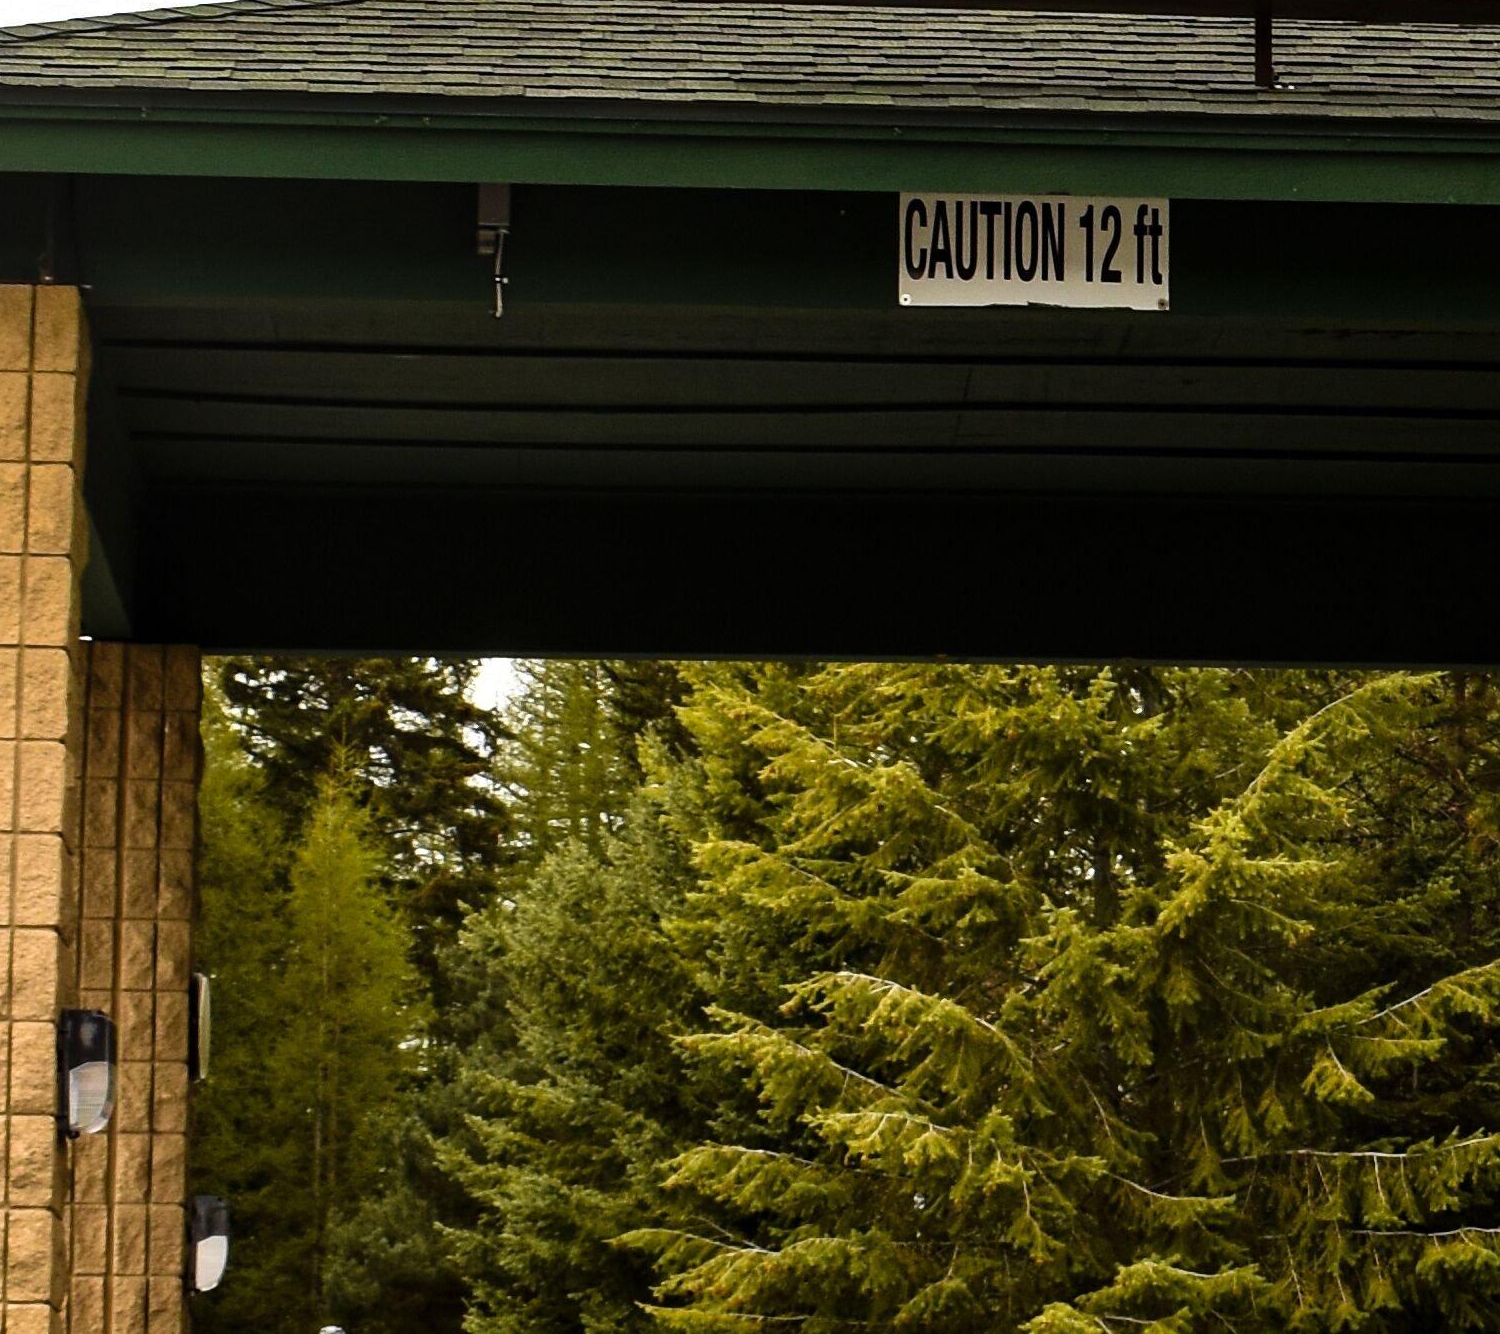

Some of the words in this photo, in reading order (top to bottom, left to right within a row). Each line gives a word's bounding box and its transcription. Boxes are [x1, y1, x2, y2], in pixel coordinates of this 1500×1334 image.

[904, 198, 1066, 282] CAUTION
[1079, 204, 1122, 283] 12
[1133, 203, 1163, 285] ft
